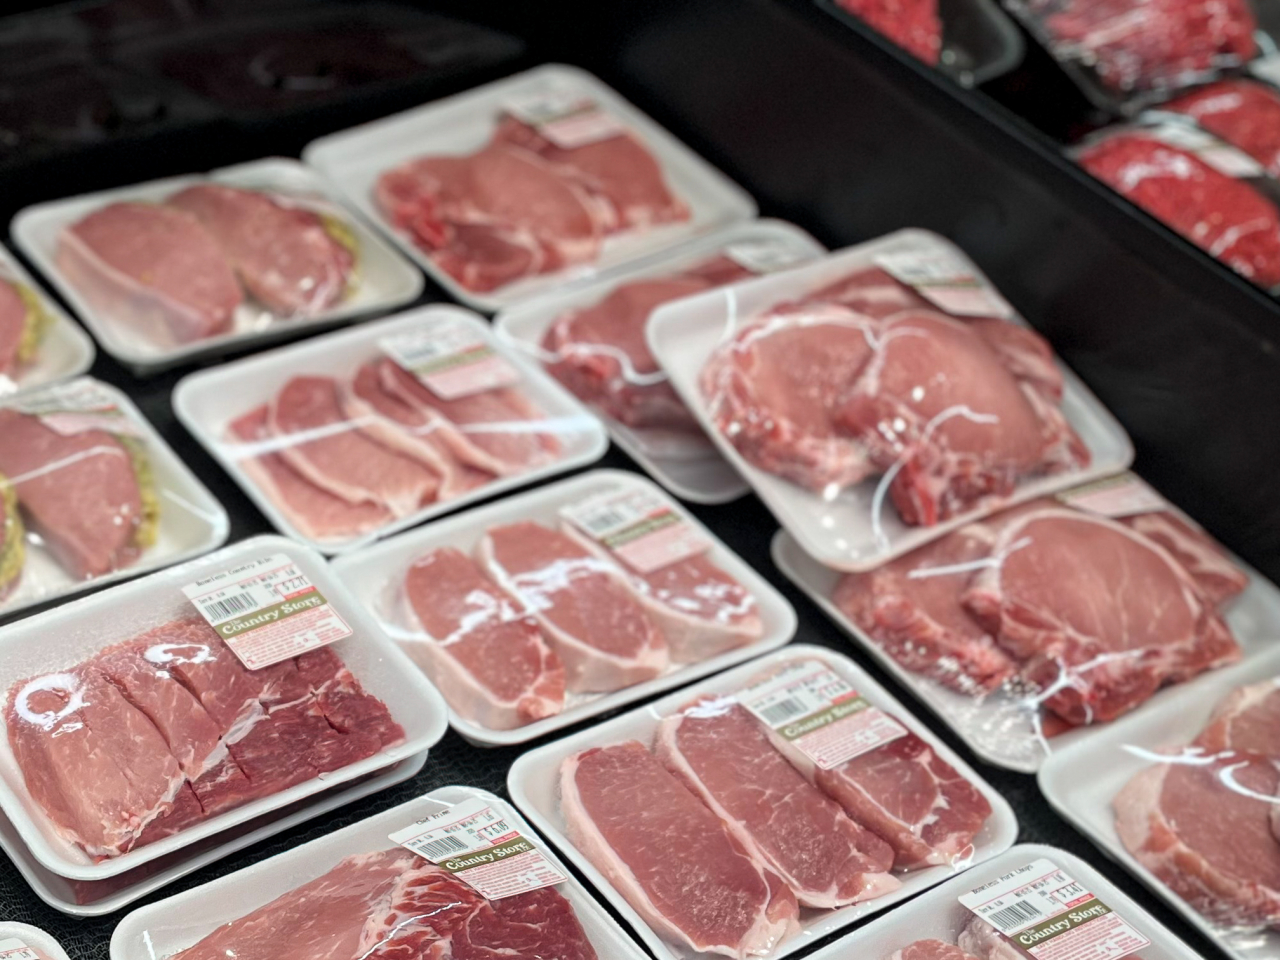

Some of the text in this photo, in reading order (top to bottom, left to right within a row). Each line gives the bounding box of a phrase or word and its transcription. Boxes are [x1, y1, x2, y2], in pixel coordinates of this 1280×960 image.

[222, 596, 320, 634] Country Store
[431, 809, 451, 820] Prime
[491, 820, 510, 835] 6.09
[445, 840, 528, 871] Country Store
[971, 879, 1000, 894] Boneless
[1000, 869, 1015, 882] Pork
[1065, 882, 1083, 896] 3.41
[1019, 904, 1103, 945] Country Store
